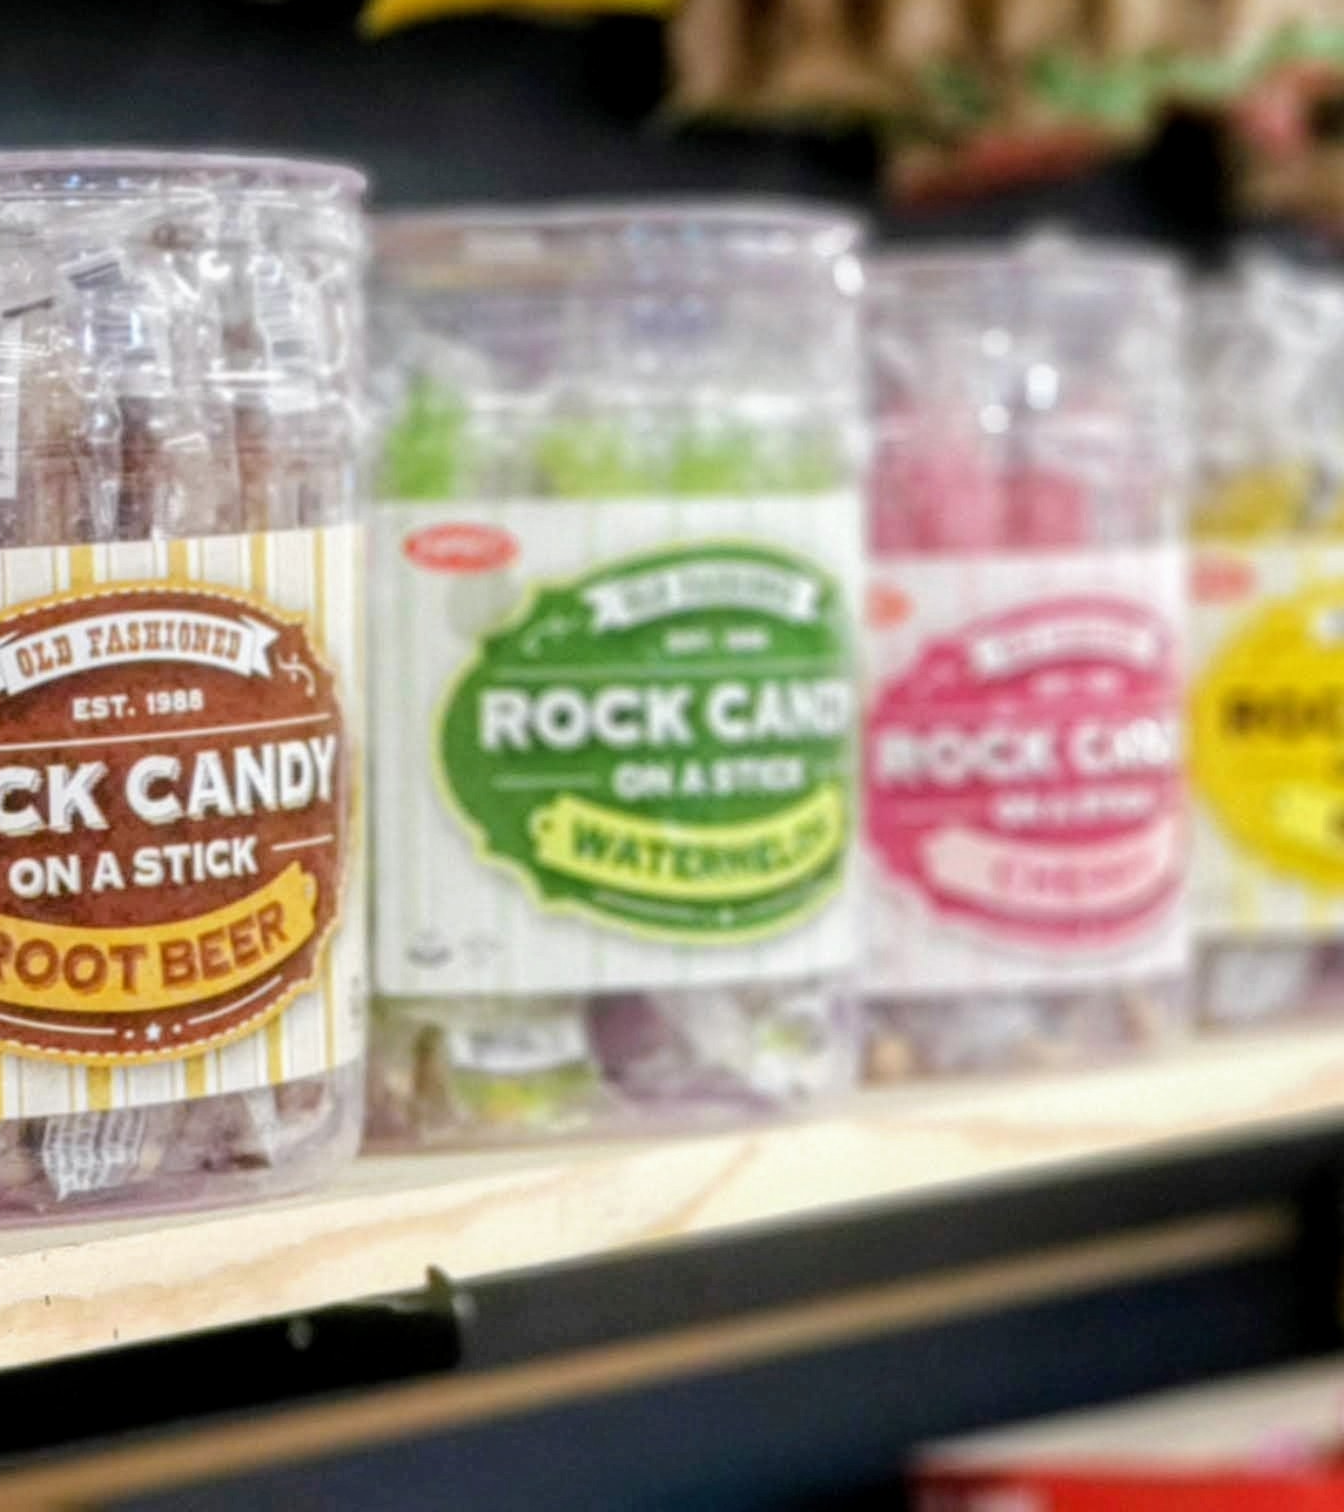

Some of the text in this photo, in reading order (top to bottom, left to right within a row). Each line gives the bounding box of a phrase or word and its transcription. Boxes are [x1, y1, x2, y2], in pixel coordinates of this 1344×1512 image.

[14, 617, 244, 680] OLD FASHIONED
[72, 688, 205, 722] EST. 1988
[479, 680, 852, 753] ROCK CAND
[125, 734, 338, 827] CANDY
[8, 835, 260, 900] ON A STICK
[158, 901, 290, 989] BEER
